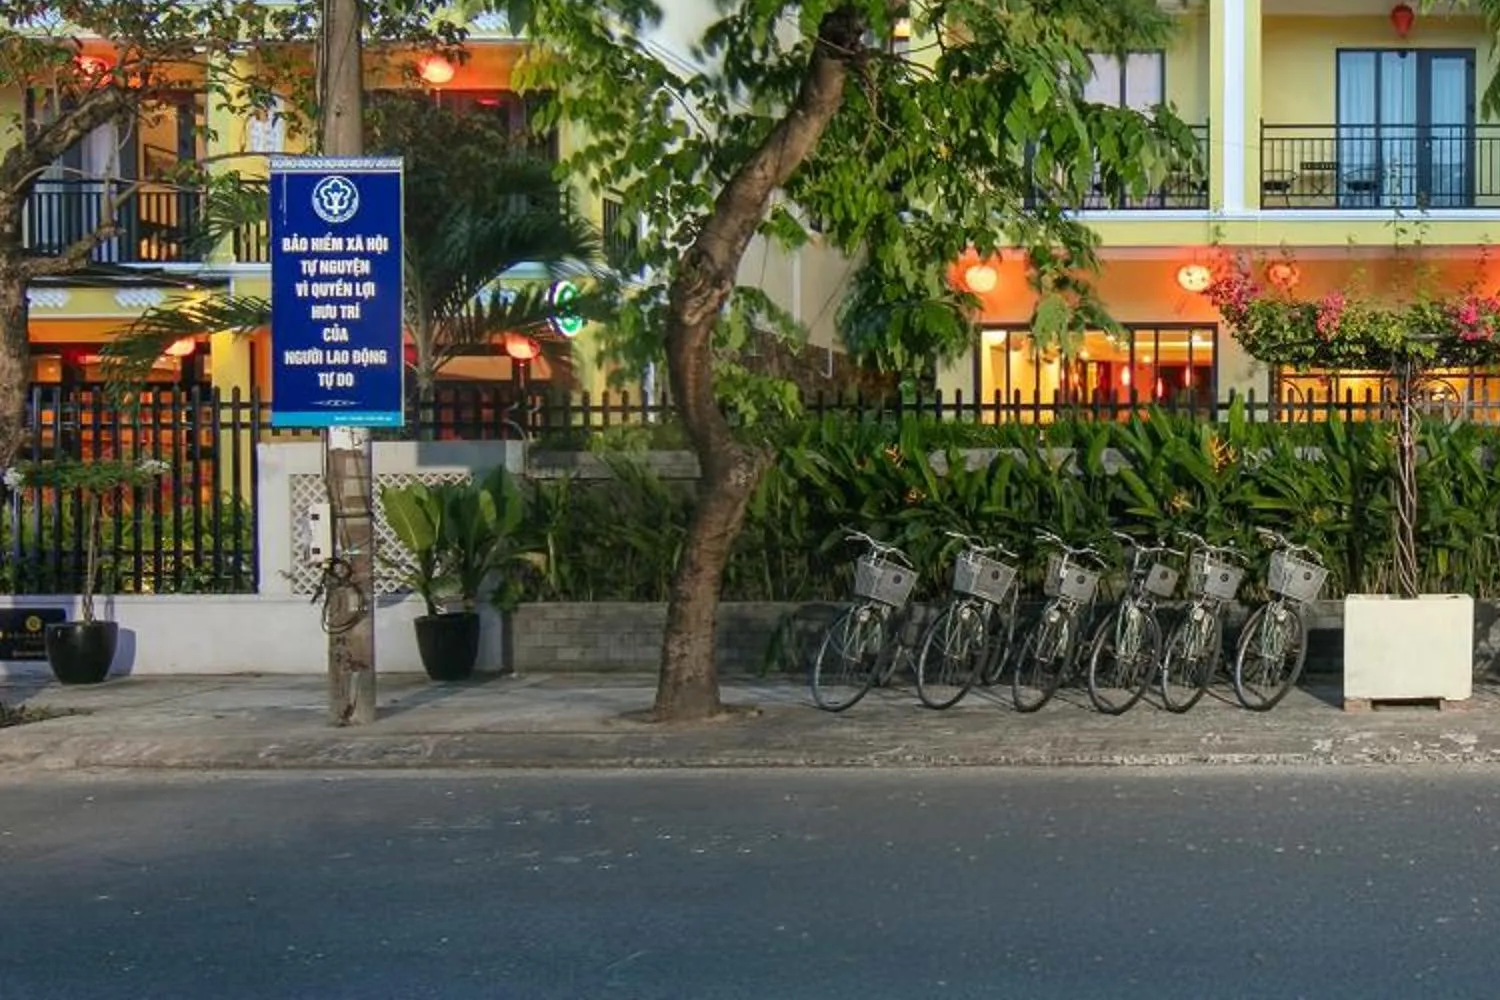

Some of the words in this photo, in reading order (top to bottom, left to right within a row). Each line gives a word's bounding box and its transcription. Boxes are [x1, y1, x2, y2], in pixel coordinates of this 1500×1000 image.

[282, 233, 309, 252] BẢO
[311, 231, 343, 252] HIỂM
[346, 233, 364, 252] XÃ
[366, 233, 389, 254] HỘI
[301, 259, 319, 277] TỰ
[319, 257, 371, 277] NGUYỆN
[295, 279, 309, 297] VÌ
[311, 278, 353, 298] QUYỀN
[355, 281, 376, 299] LỢI
[339, 302, 361, 319] TRÍ
[323, 323, 349, 342] CỦA
[284, 347, 323, 365] NGƯỜI
[325, 350, 350, 365] LAO
[352, 347, 388, 367] ĐỘNG
[318, 372, 335, 390] TỰ
[336, 372, 354, 387] DO
